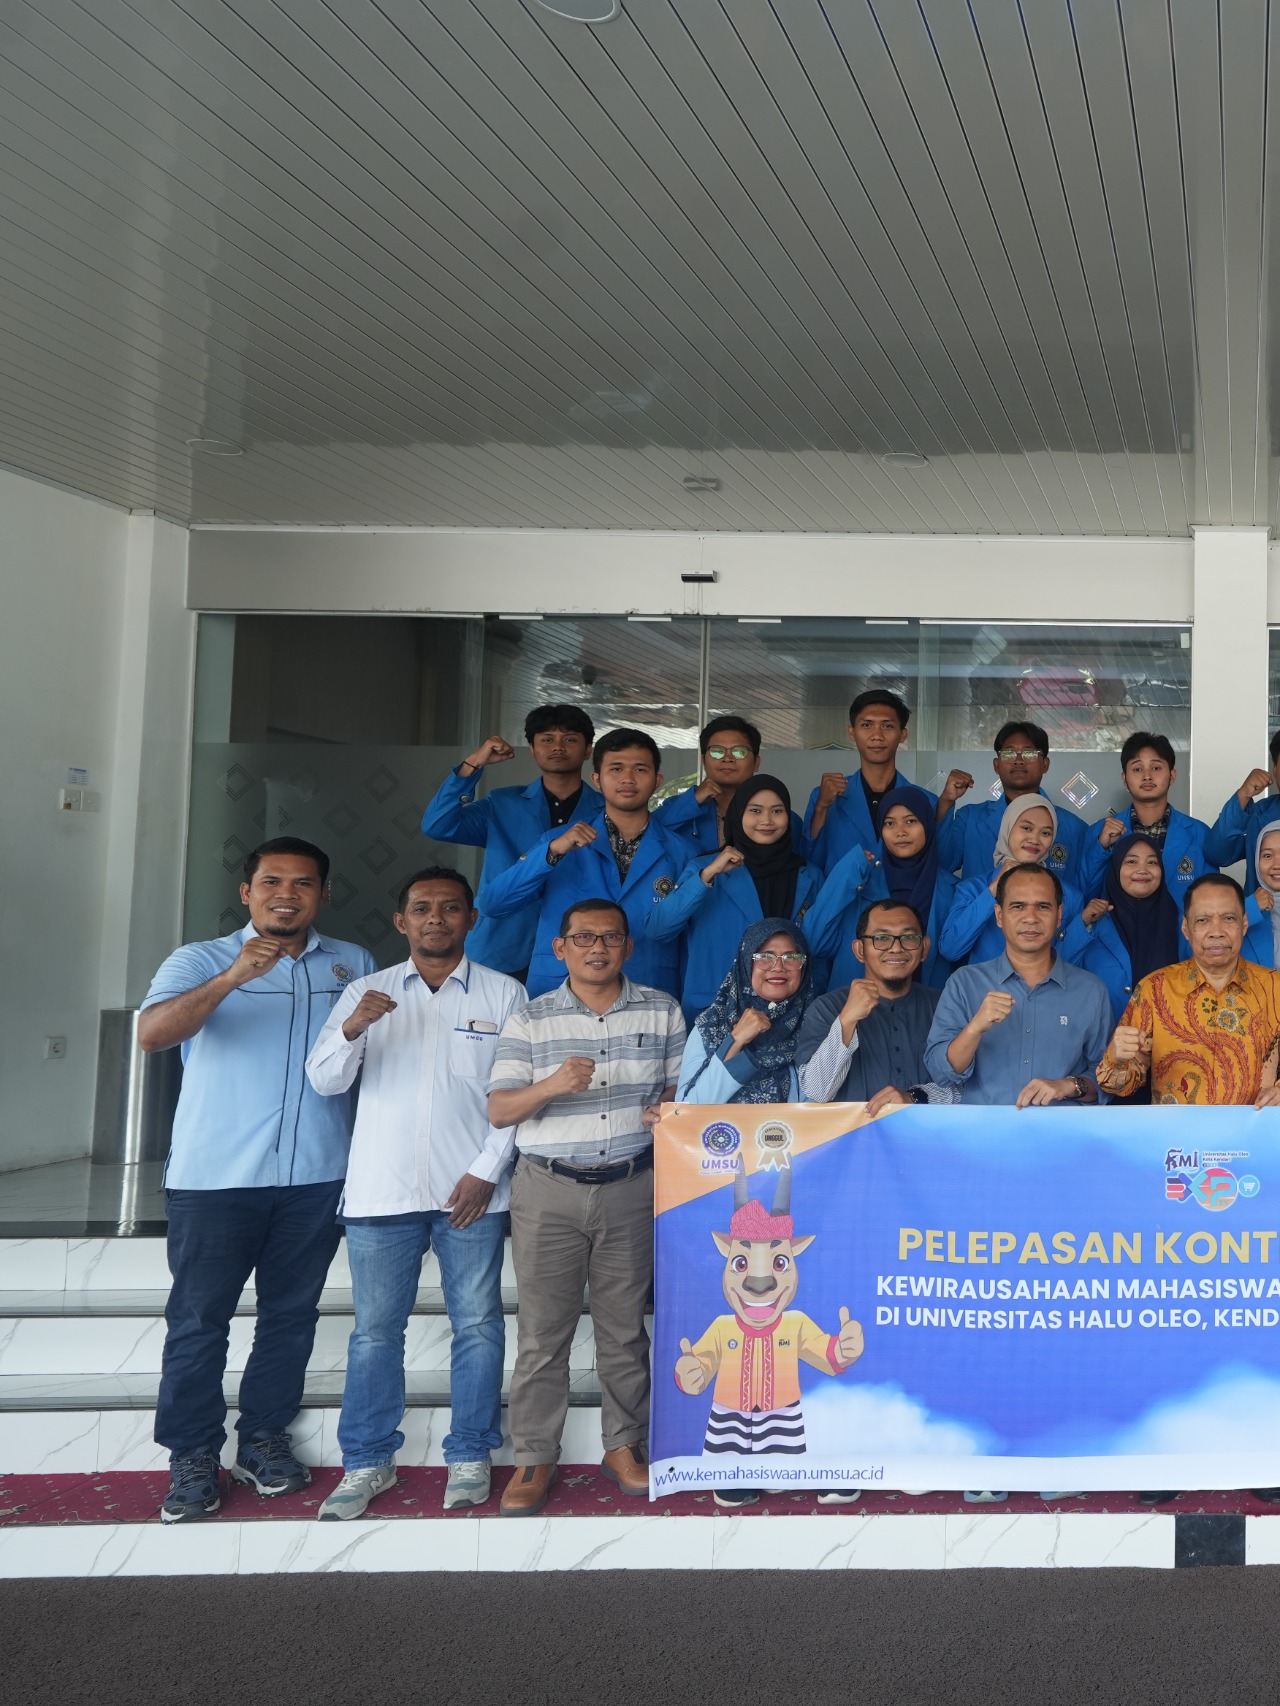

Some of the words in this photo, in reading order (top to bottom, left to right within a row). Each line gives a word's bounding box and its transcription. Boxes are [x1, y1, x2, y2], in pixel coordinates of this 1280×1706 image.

[702, 1160, 738, 1169] UMSU
[899, 1228, 1142, 1264] PELEPASAN
[877, 1276, 1110, 1300] KEWIRAUSAHAAN
[876, 1306, 899, 1326] DI
[906, 1308, 1062, 1330] UNIVERSITAS
[1068, 1310, 1132, 1329] HALU
[1139, 1309, 1208, 1331] OLEO,
[656, 1466, 884, 1486] www.kemahasiswaan.umsu.ac.id
